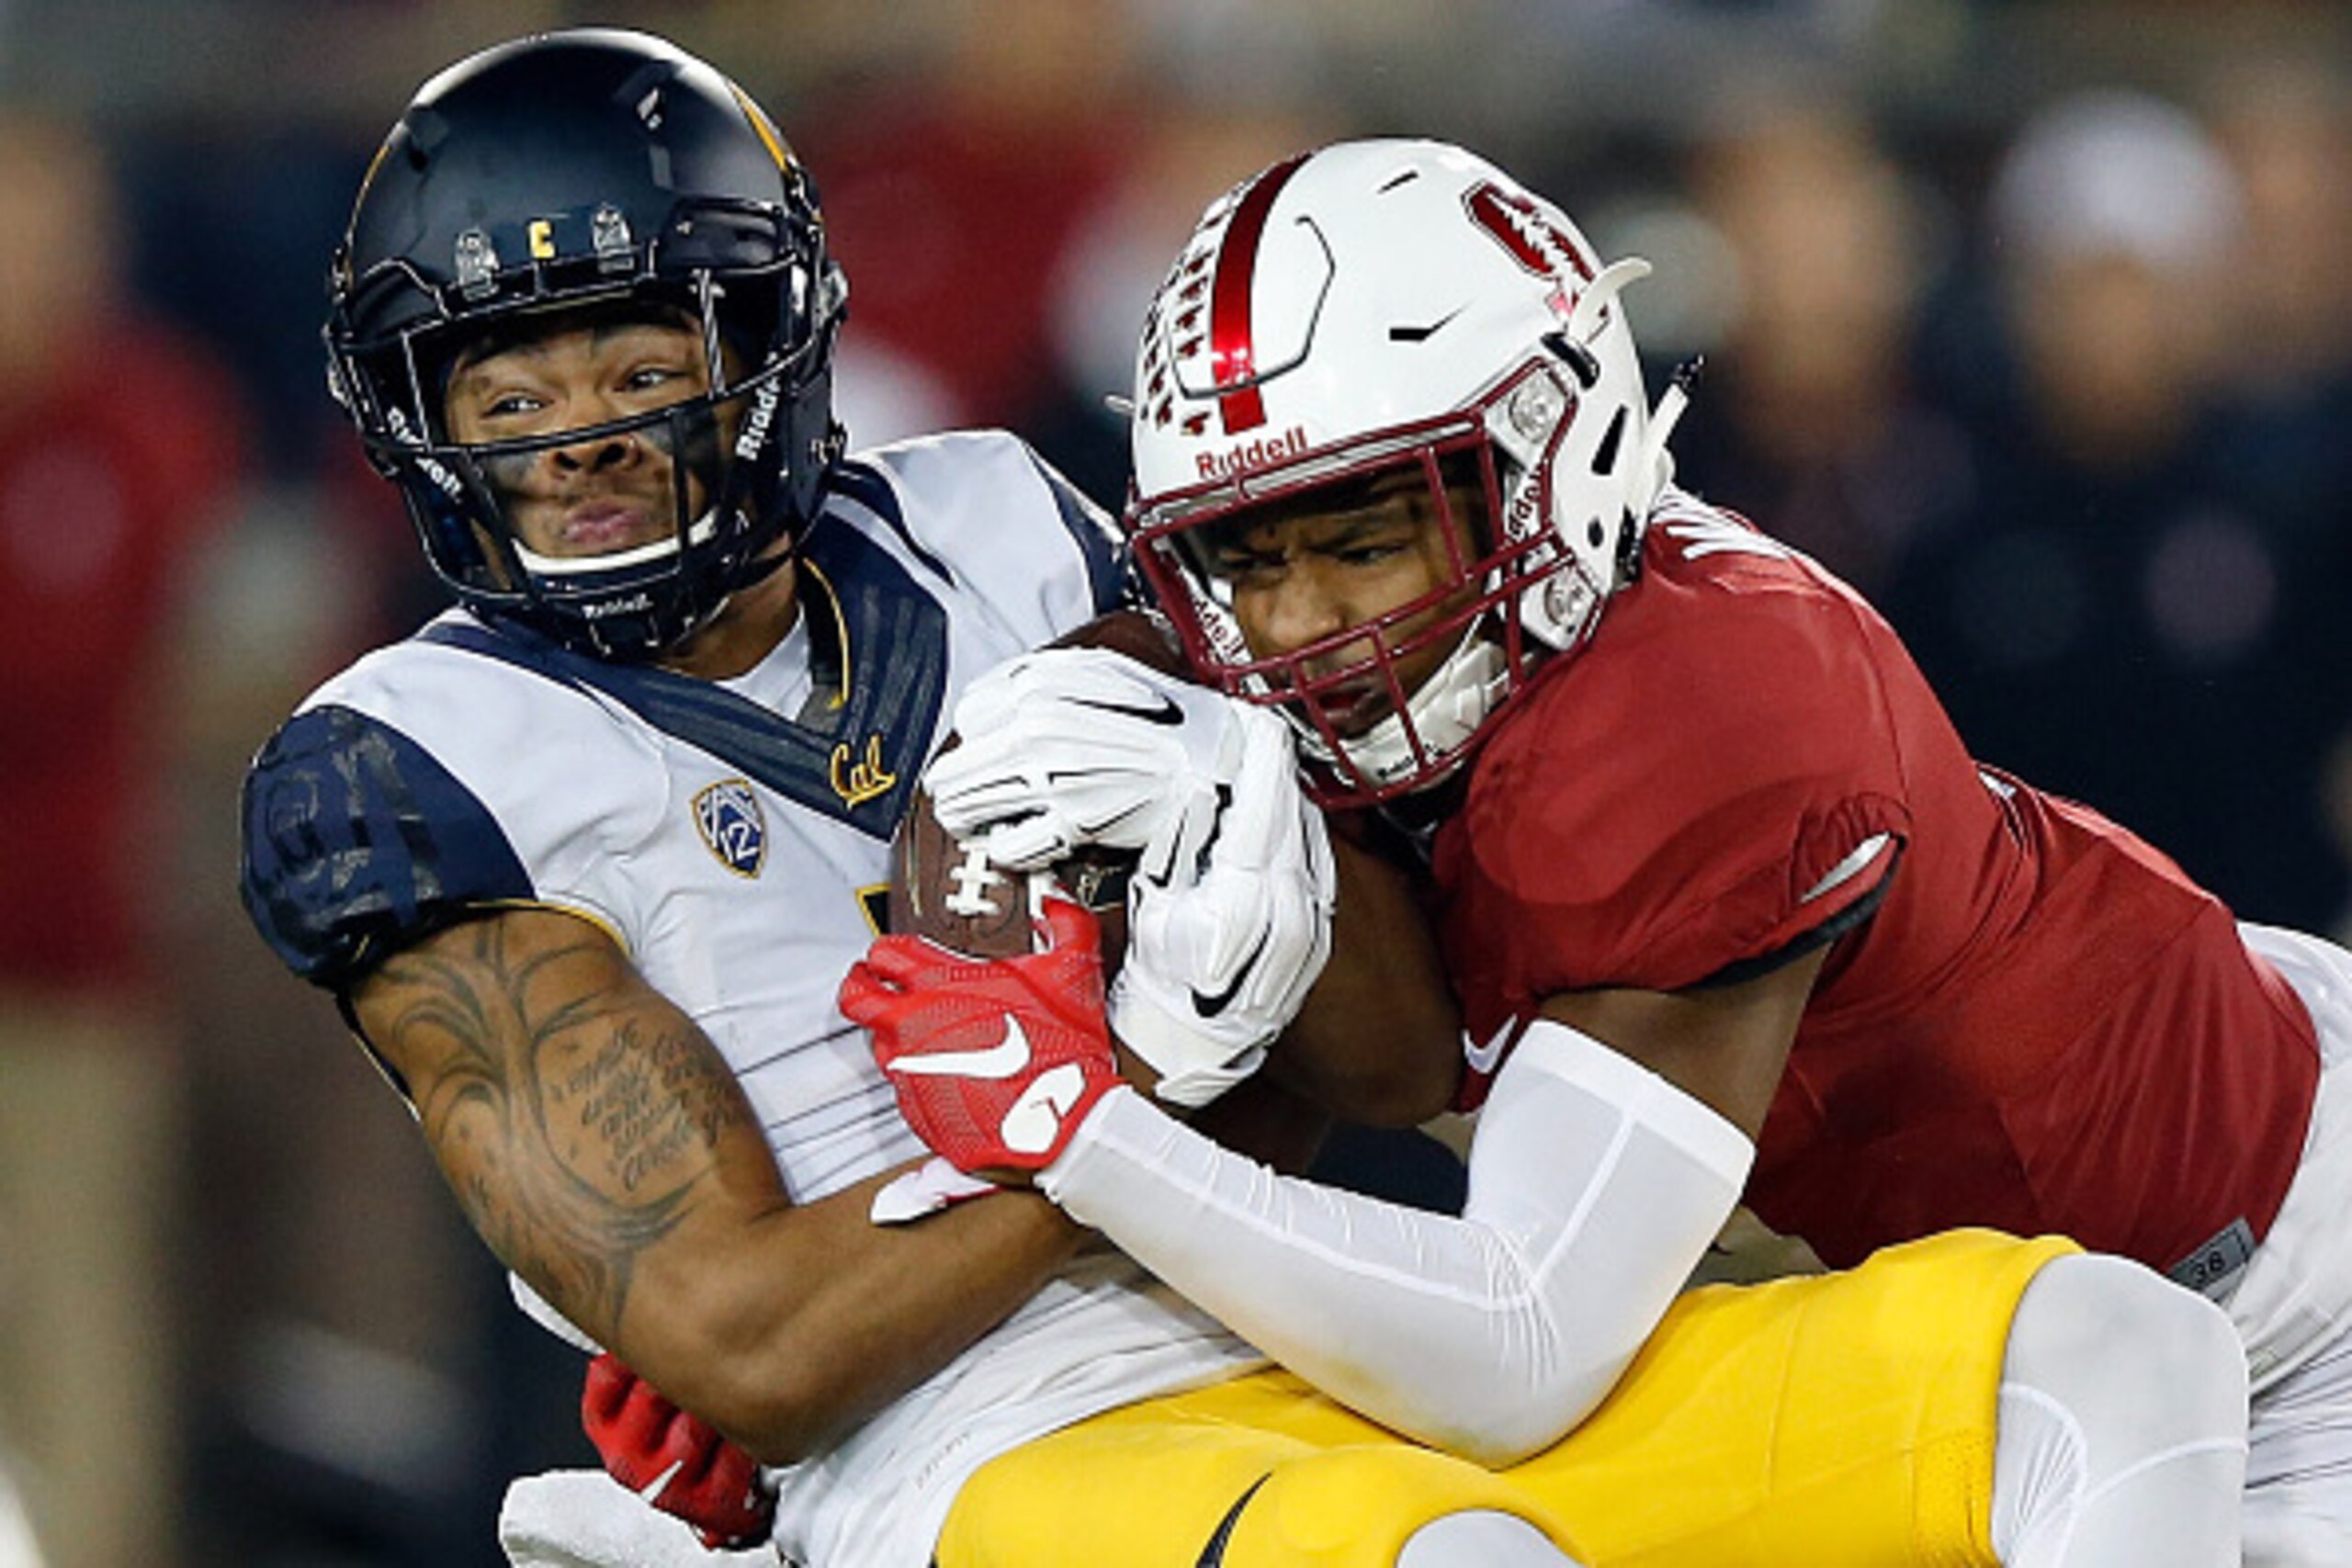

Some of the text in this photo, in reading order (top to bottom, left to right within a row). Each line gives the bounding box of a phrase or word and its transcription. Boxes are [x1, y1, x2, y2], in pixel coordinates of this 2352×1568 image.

[529, 220, 556, 258] C
[1195, 424, 1307, 478] Riddell
[830, 733, 896, 810] Cal
